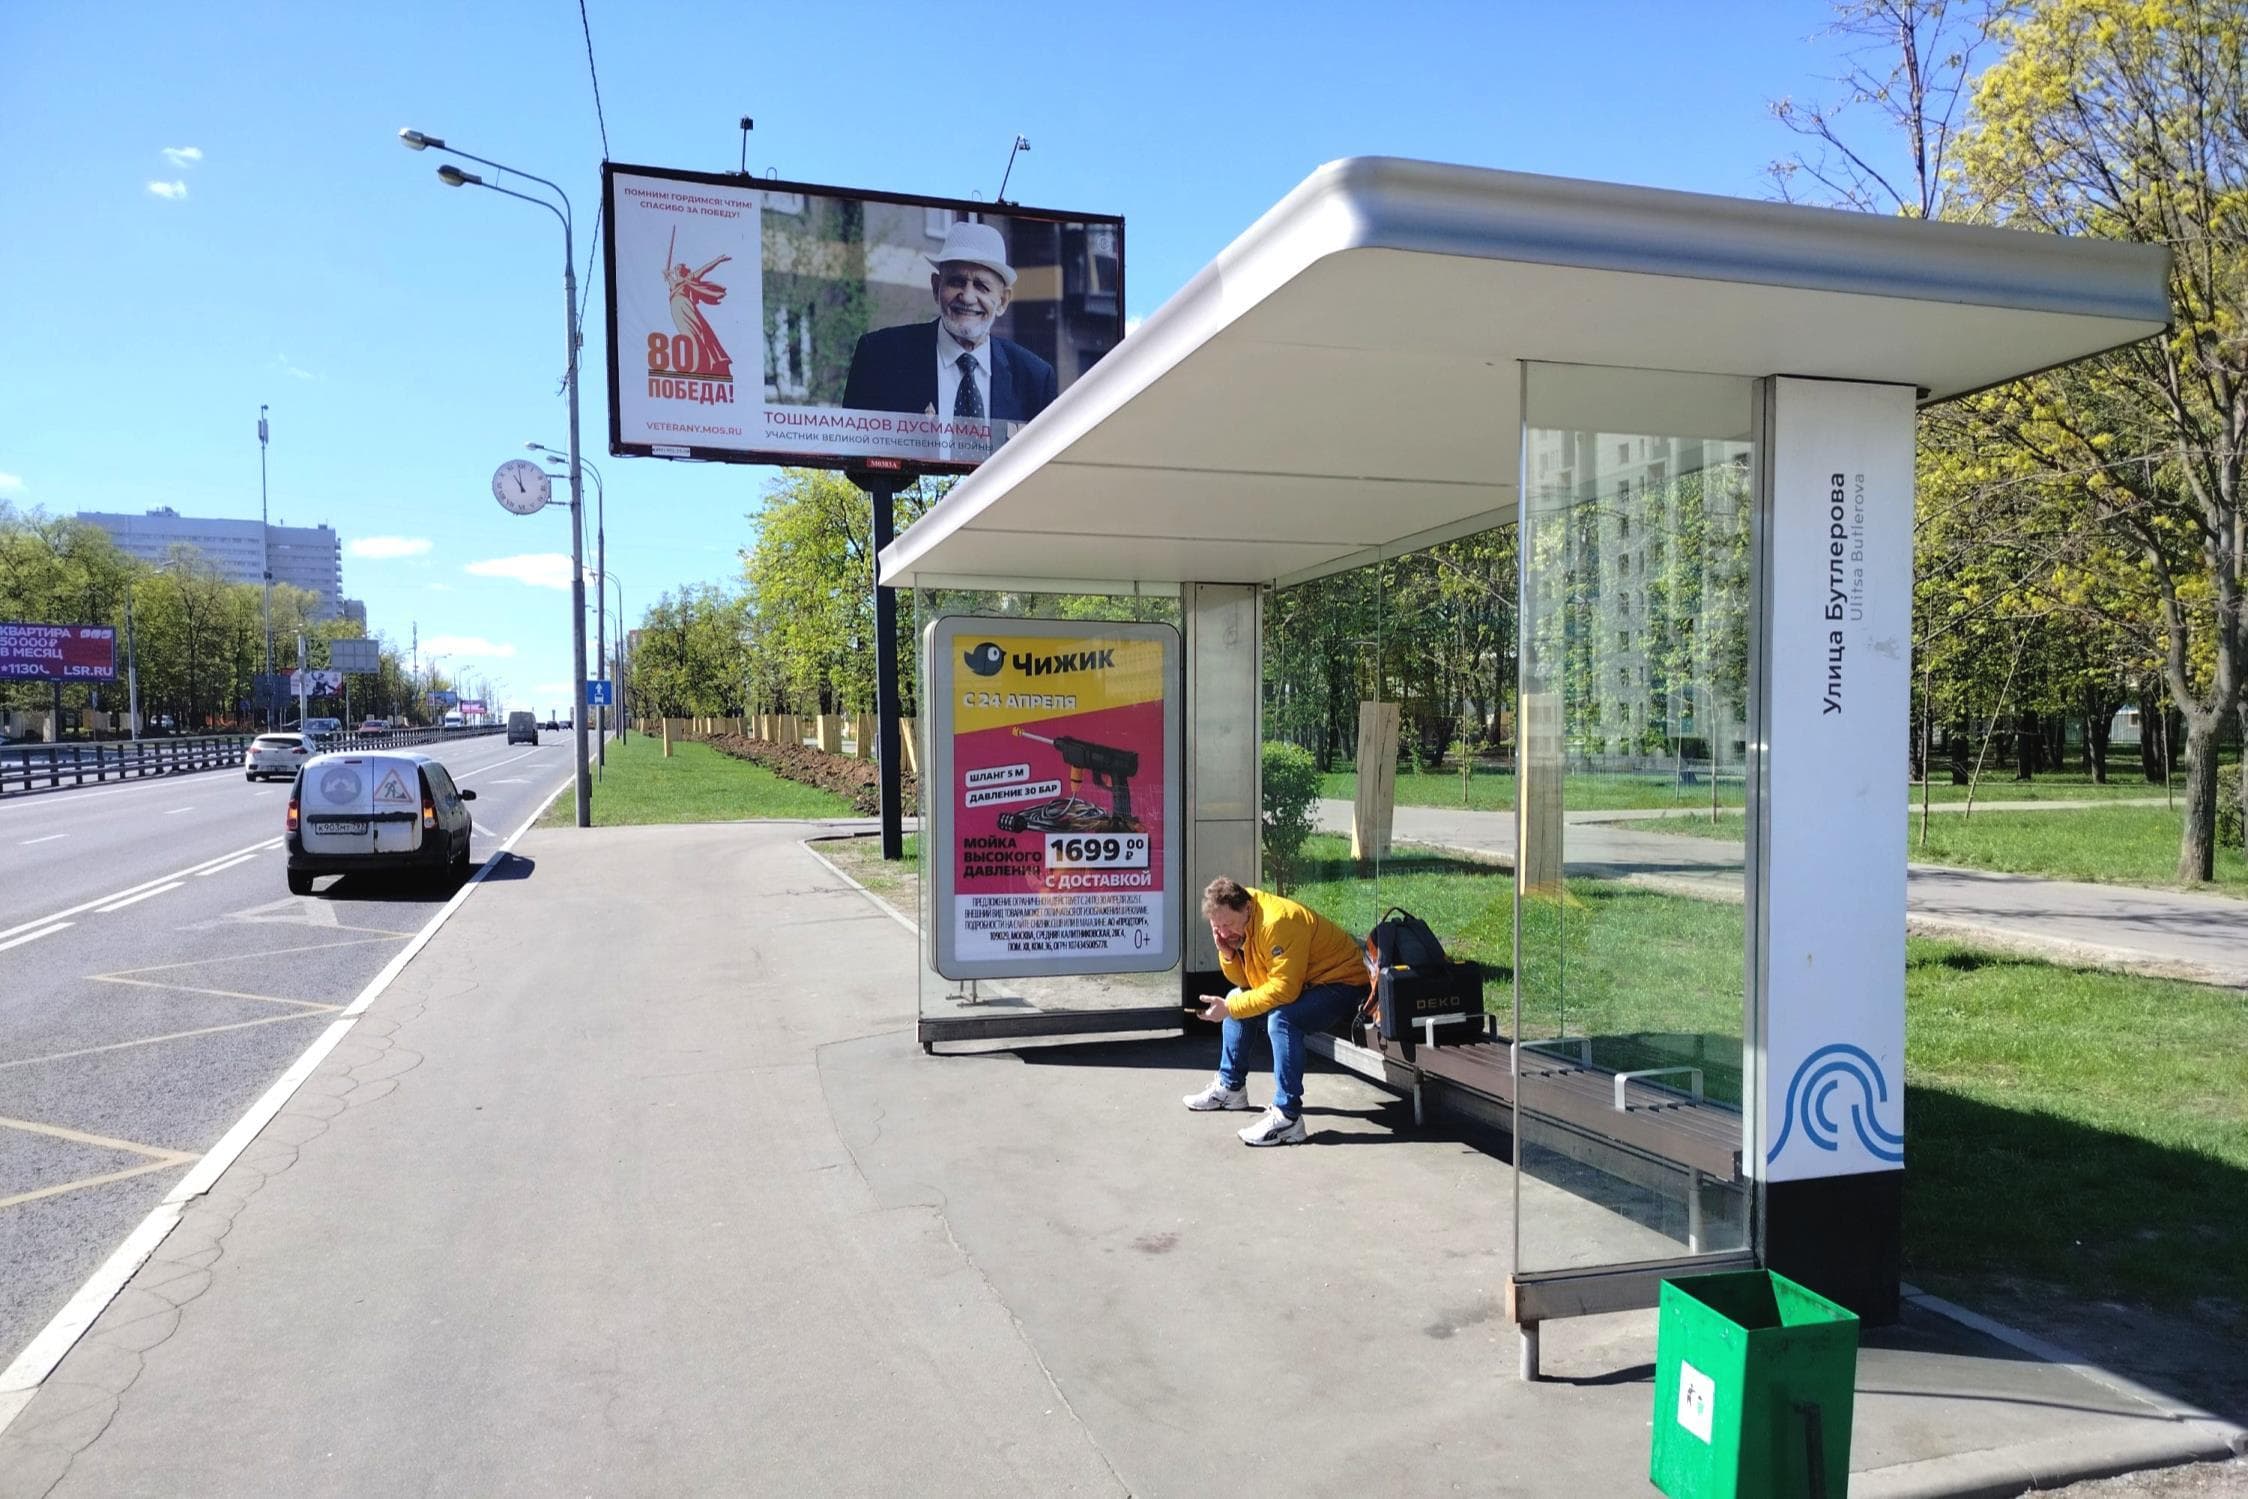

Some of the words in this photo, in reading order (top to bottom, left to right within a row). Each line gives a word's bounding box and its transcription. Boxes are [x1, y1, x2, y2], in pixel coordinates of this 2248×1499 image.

[624, 187, 669, 199] ПОМНИМ!
[671, 193, 722, 206] ГОРДИМСЯ!
[724, 199, 752, 209] ЧТИМ!
[640, 201, 684, 212] СПАСИБО
[700, 208, 740, 219] ПОБЕДУ!
[647, 332, 694, 372] 80
[648, 378, 734, 405] ПОБЕДА!
[646, 421, 742, 436] VETERANY.MOS.RU
[763, 411, 892, 431] ТОШМАМАДОВ
[896, 417, 993, 439] ДУСМАМАД
[765, 430, 819, 441] УЧАСТНИК
[822, 433, 870, 445] ВЕЛИКОЙ
[872, 436, 955, 449] ОТЕЧЕСТВЕННОЙ
[957, 440, 993, 451] ВОЙНЫ
[1850, 473, 1865, 562] Butlerova
[1825, 472, 1848, 621] Бутлерова
[1851, 568, 1864, 621] Ulitsa
[0, 626, 71, 638] КВАРТИРА
[0, 637, 17, 647] 50
[19, 637, 48, 647] 000
[0, 647, 10, 656] В
[13, 648, 63, 659] МЕСЯЦ
[63, 665, 112, 676] LSR.RU
[1823, 631, 1846, 715] Улица
[963, 692, 976, 709] С
[978, 692, 1001, 709] 24
[1005, 693, 1077, 710] АПРЕЛЯ
[969, 770, 1006, 782] ШЛАНГ
[1007, 769, 1013, 778] 5
[1015, 768, 1024, 776] М
[969, 788, 1022, 804] ДАВЛЕНИЕ
[1024, 787, 1036, 796] 30
[1038, 784, 1057, 794] БАР
[963, 834, 1017, 849] МОЙКА
[1050, 838, 1120, 862] 1699
[1126, 838, 1144, 849] 00
[963, 851, 1042, 862] ВЫСОКОГО
[963, 865, 1040, 878] ДАВЛЕНИЯ
[1045, 875, 1055, 887] С
[1058, 870, 1151, 889] ДОСТАВКОЙ
[1134, 928, 1151, 949] 0+
[1416, 996, 1460, 1009] DEKO
